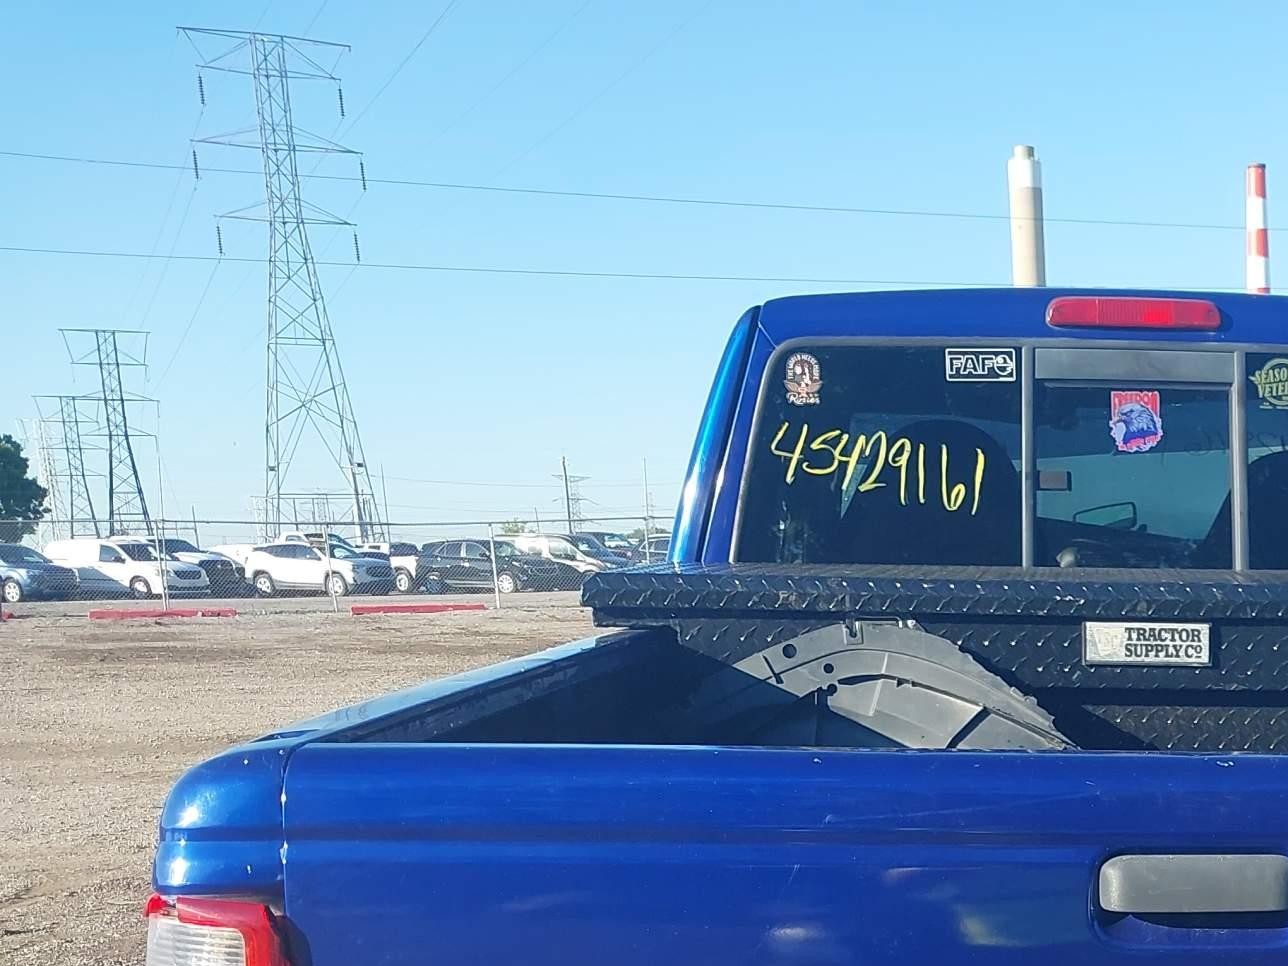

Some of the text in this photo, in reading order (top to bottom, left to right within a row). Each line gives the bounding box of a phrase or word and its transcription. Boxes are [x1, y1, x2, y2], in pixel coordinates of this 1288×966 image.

[771, 422, 985, 515] 45429161
[1124, 627, 1202, 642] TRACTOR
[1124, 643, 1183, 658] SUPPLY
